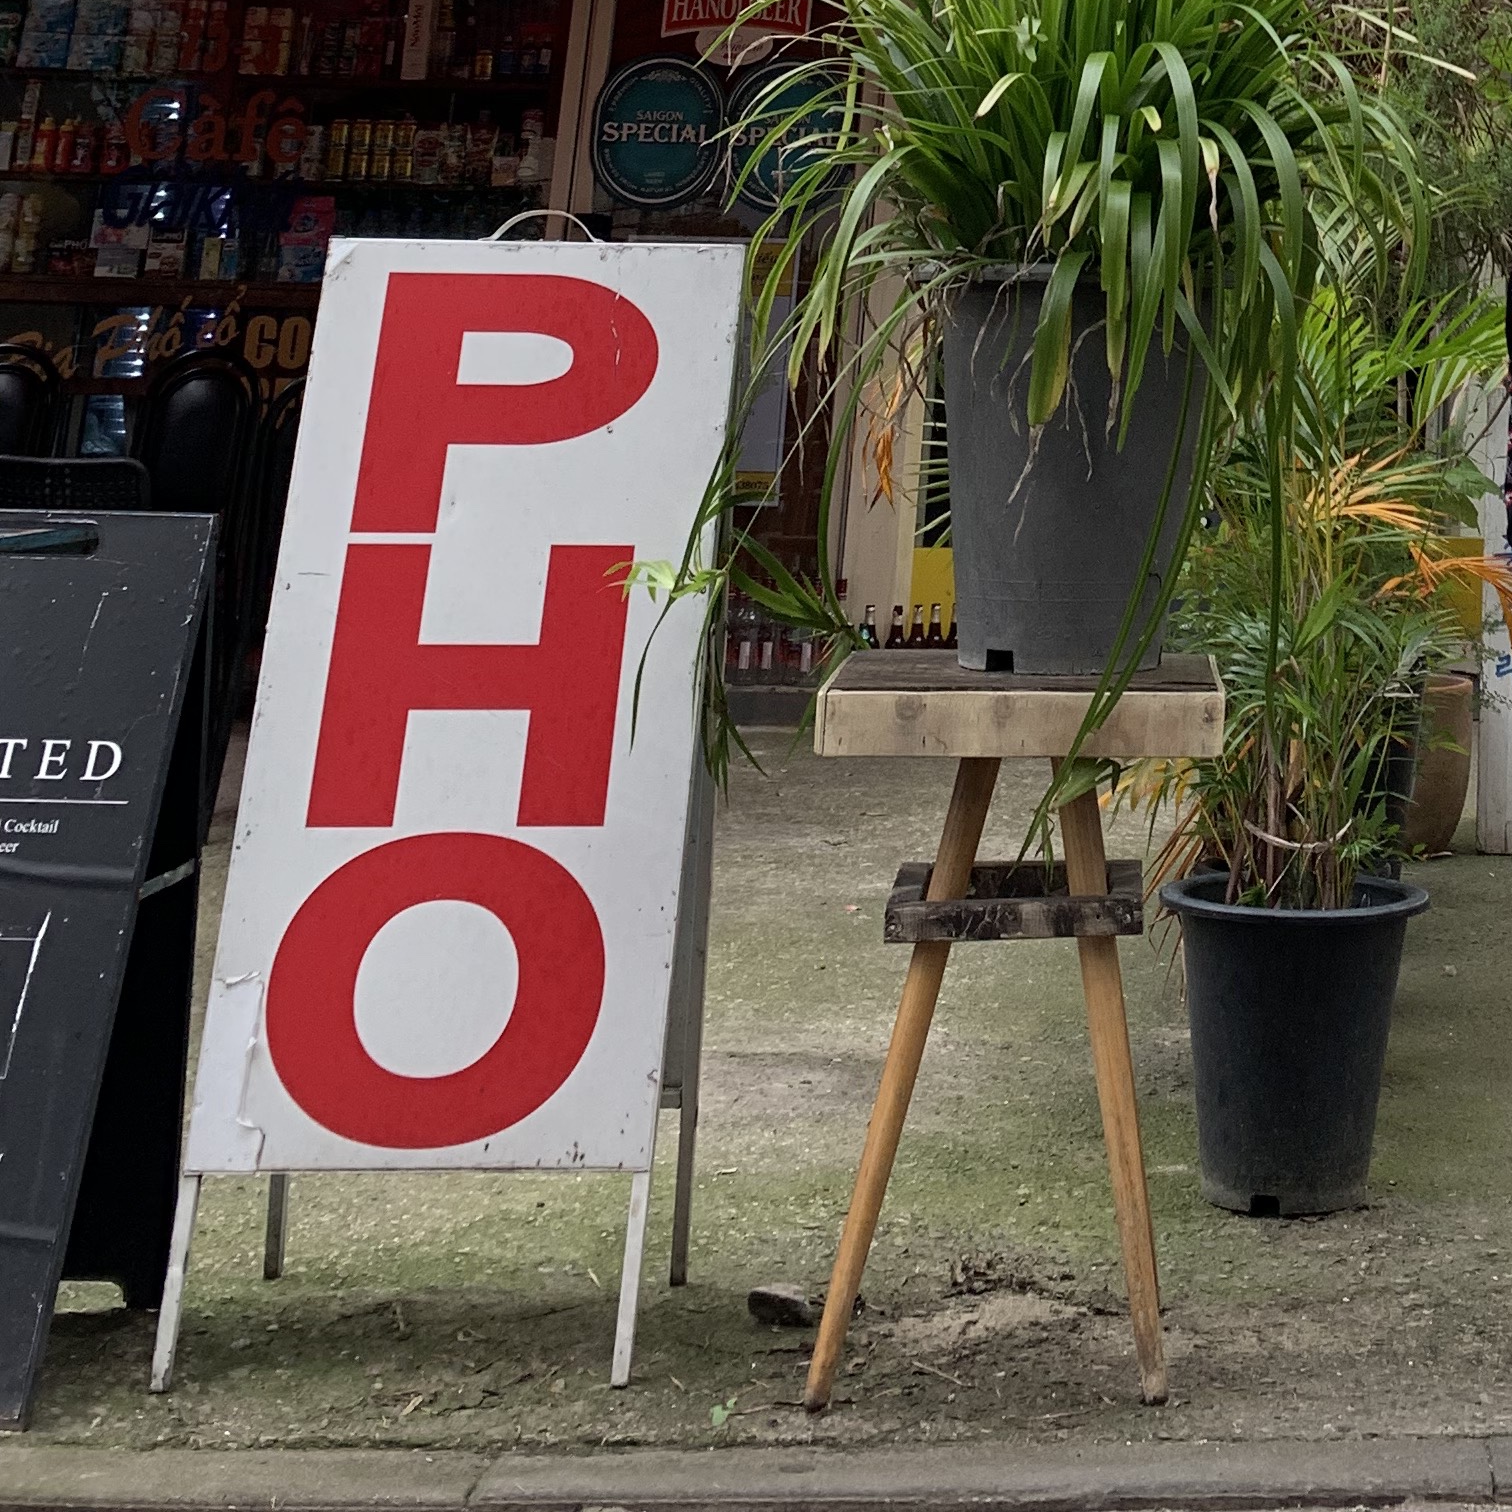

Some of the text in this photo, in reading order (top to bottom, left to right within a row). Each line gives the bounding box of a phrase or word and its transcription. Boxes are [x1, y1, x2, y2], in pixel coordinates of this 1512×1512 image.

[635, 109, 684, 122] SAIGON
[265, 271, 660, 1150] PHO
[3, 818, 60, 834] Cocktail
